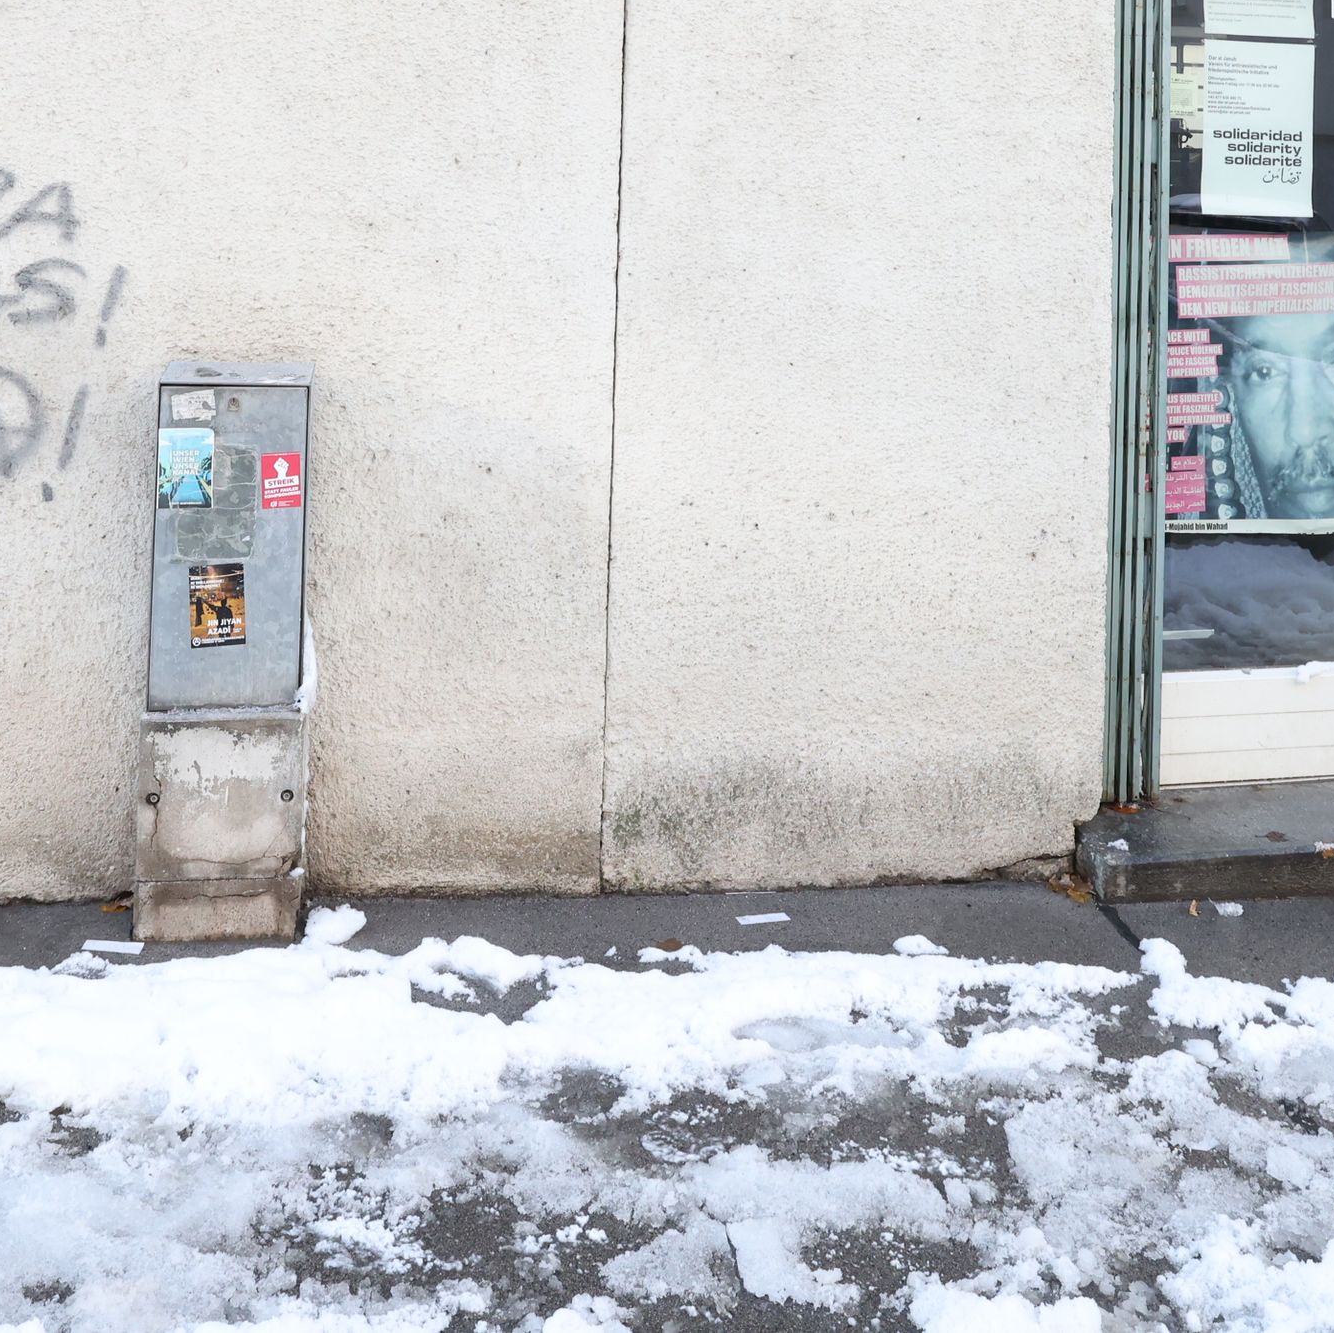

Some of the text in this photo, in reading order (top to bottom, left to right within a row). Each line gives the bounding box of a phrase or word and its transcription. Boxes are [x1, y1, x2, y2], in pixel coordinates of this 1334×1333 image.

[1213, 128, 1302, 142] solidaridad
[1227, 141, 1302, 157] solidarity
[1168, 238, 1182, 259] IN
[1186, 237, 1251, 258] FRIEDEN
[1178, 267, 1266, 282] RASSISTISCHER
[1179, 282, 1279, 299] DEMOKRATISCHEM
[1179, 302, 1204, 316] DEM
[1204, 301, 1228, 316] NEW
[1230, 300, 1252, 315] AGE
[1167, 331, 1182, 343] ACE
[1168, 357, 1184, 366] ATIC
[268, 478, 295, 487] STREIK
[1195, 522, 1206, 530] bin
[1206, 522, 1228, 530] Wahad
